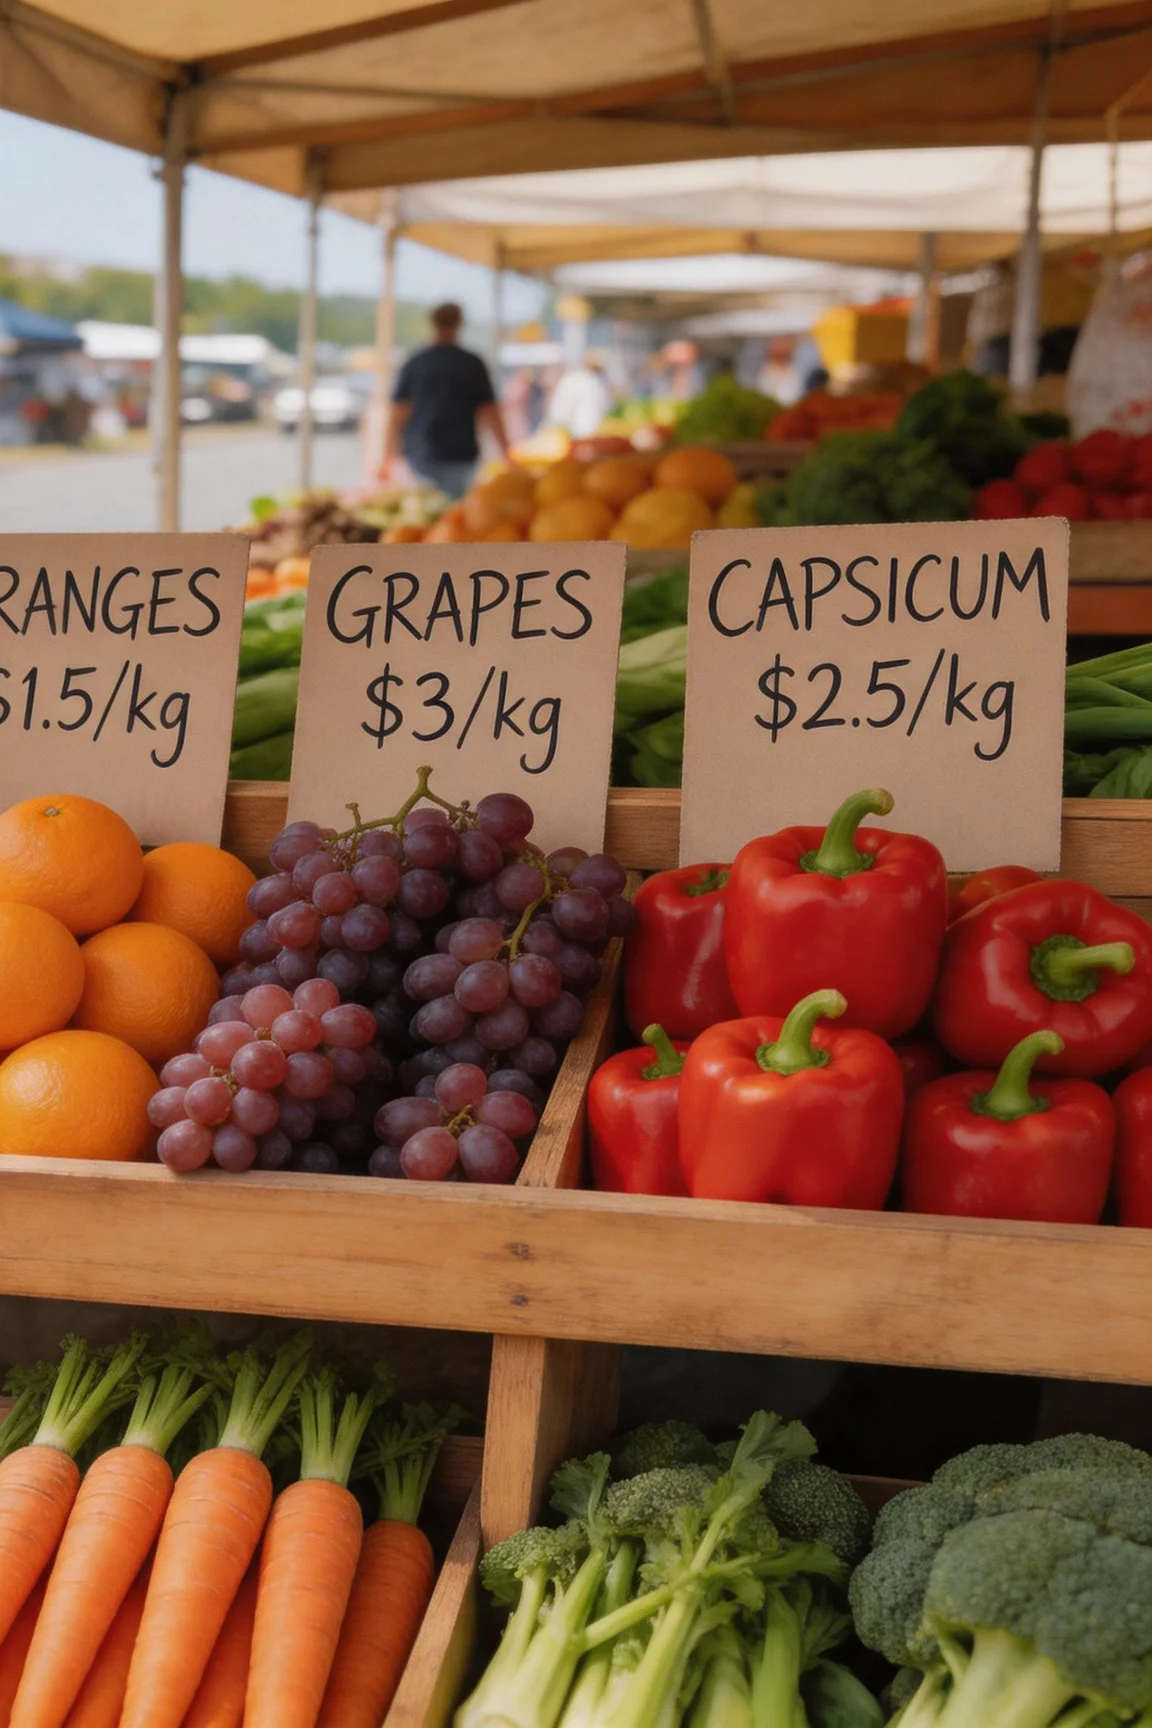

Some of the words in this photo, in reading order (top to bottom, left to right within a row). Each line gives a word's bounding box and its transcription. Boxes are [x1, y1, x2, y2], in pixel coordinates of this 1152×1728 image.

[326, 564, 594, 649] GRAPES
[707, 546, 1052, 639] CAPSICUM
[360, 662, 563, 776] $3/kg
[752, 648, 1016, 763] $2.5/kg
